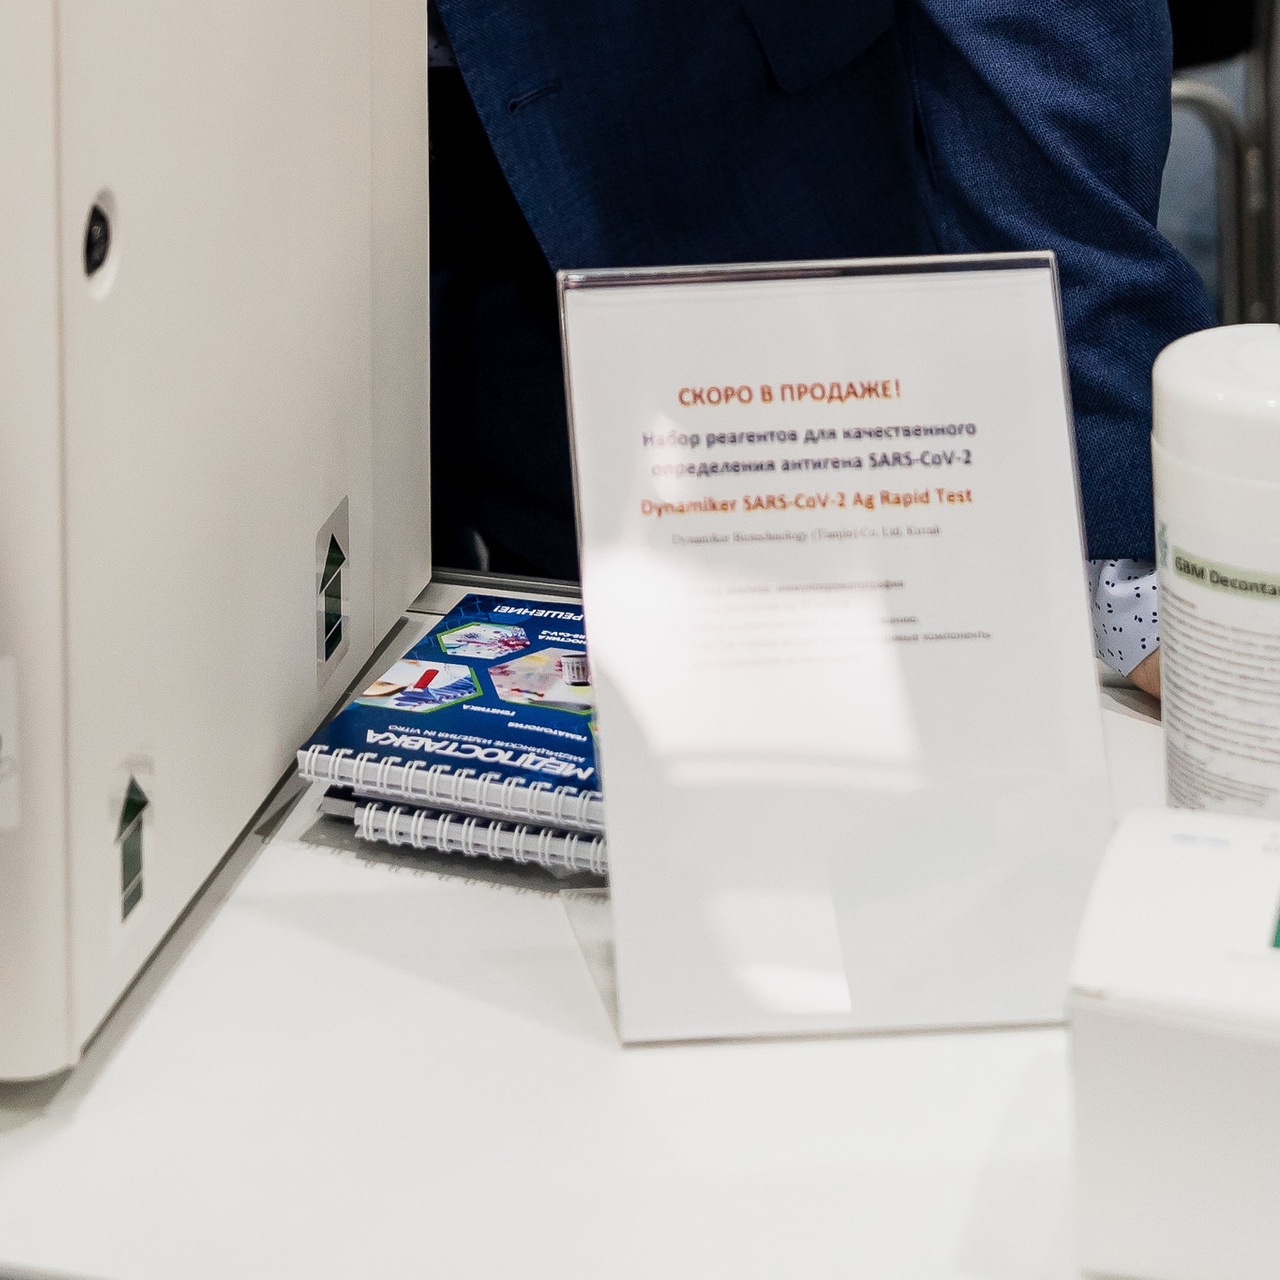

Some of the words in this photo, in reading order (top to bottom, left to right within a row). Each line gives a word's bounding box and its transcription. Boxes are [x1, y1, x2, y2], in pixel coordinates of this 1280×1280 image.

[678, 385, 753, 407] СКОРО
[760, 384, 773, 403] В
[781, 378, 901, 404] ПРОДАЖЕ!
[643, 430, 699, 449] Набор
[706, 428, 797, 448] реагентов
[804, 427, 836, 445] для
[843, 422, 977, 441] качественного
[651, 458, 776, 477] определения
[781, 456, 863, 473] антигена
[869, 449, 973, 469] SARS-CoV-2
[640, 497, 737, 517] Dynamiker
[742, 492, 847, 512] SARS-CoV-2
[852, 492, 875, 510] Ag
[880, 488, 930, 509] Rapid
[935, 487, 973, 504] Test
[1175, 556, 1205, 580] GBM
[493, 605, 584, 622] РЕШЕНИЕ!
[462, 703, 516, 717] ГЕНЕТИКА
[388, 724, 421, 736] VITRO
[507, 721, 587, 742] ГЕМАТОЛОГИЯ
[366, 729, 595, 781] МЕДПОСТАВКА
[492, 738, 586, 763] МЕДИЦИНСКИЕ
